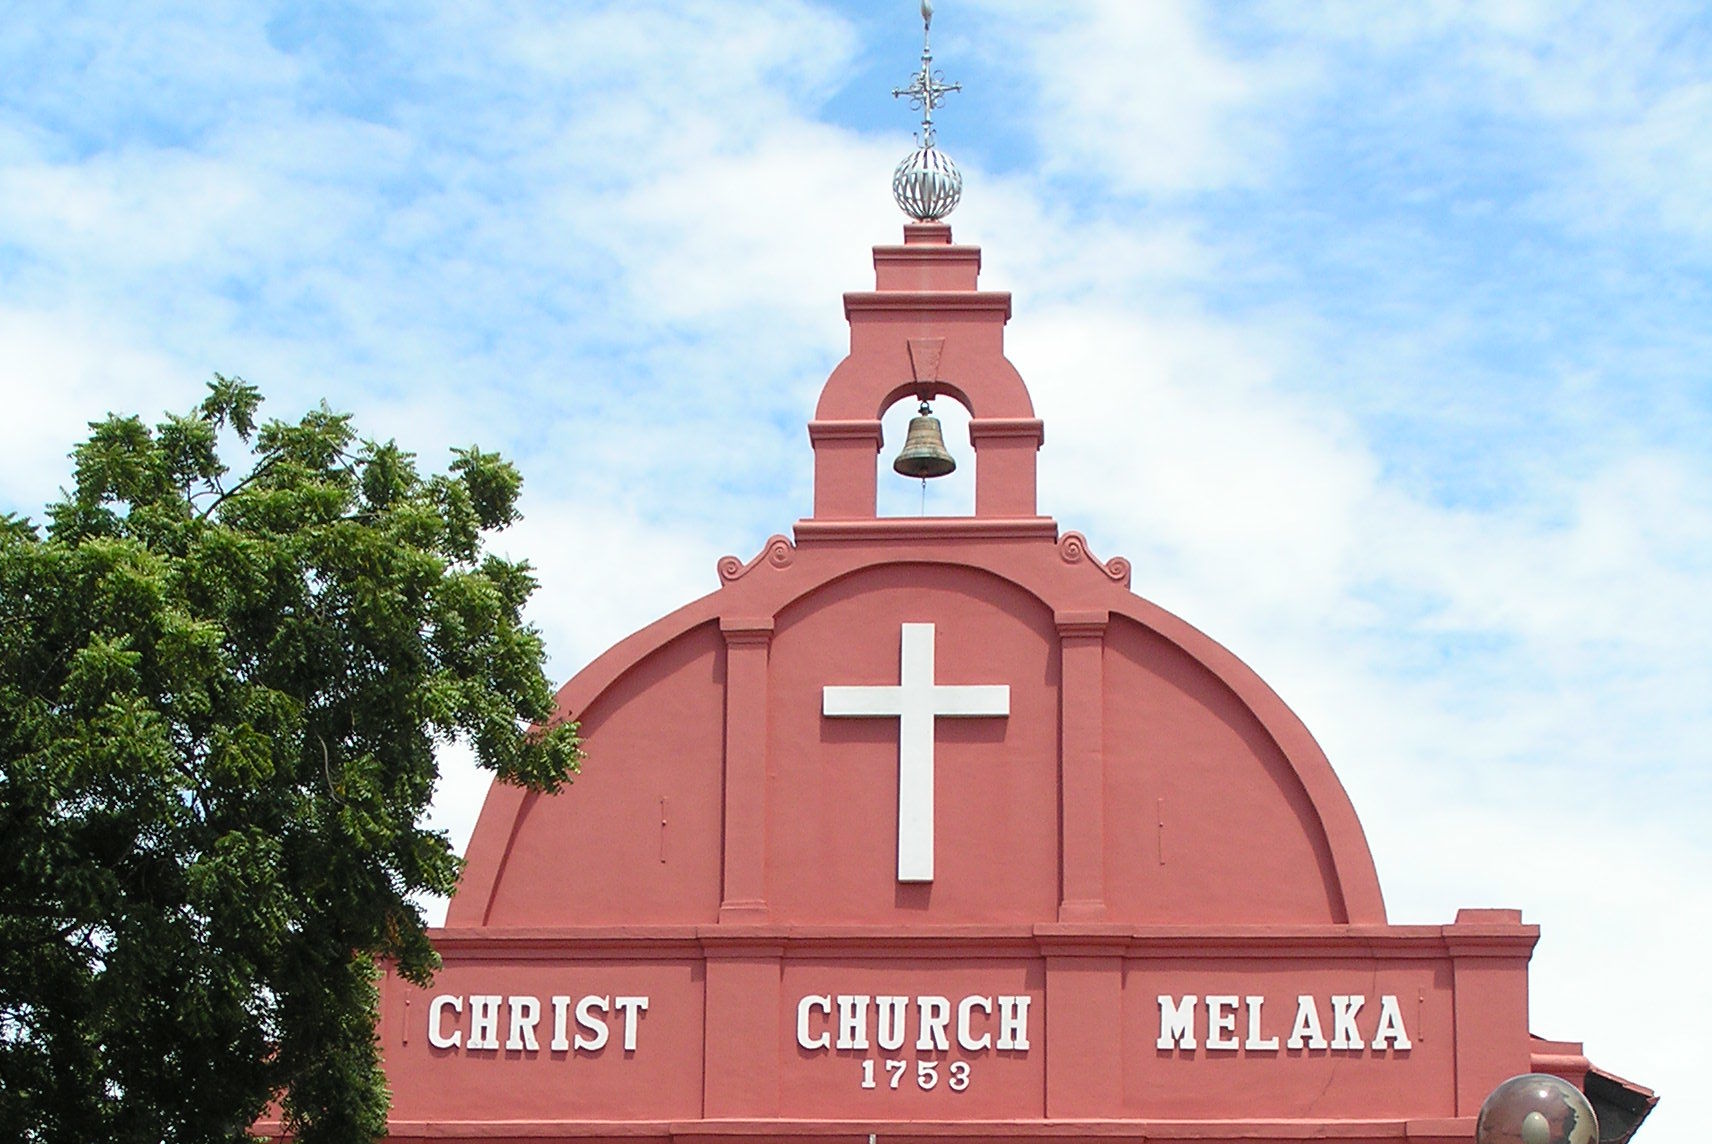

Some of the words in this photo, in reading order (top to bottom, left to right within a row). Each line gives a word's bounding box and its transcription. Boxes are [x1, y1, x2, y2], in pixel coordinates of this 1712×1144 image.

[427, 993, 650, 1052] CHRIST
[796, 993, 1032, 1052] CHURCH
[1155, 994, 1413, 1051] MELAKA
[860, 1058, 972, 1092] 1753
